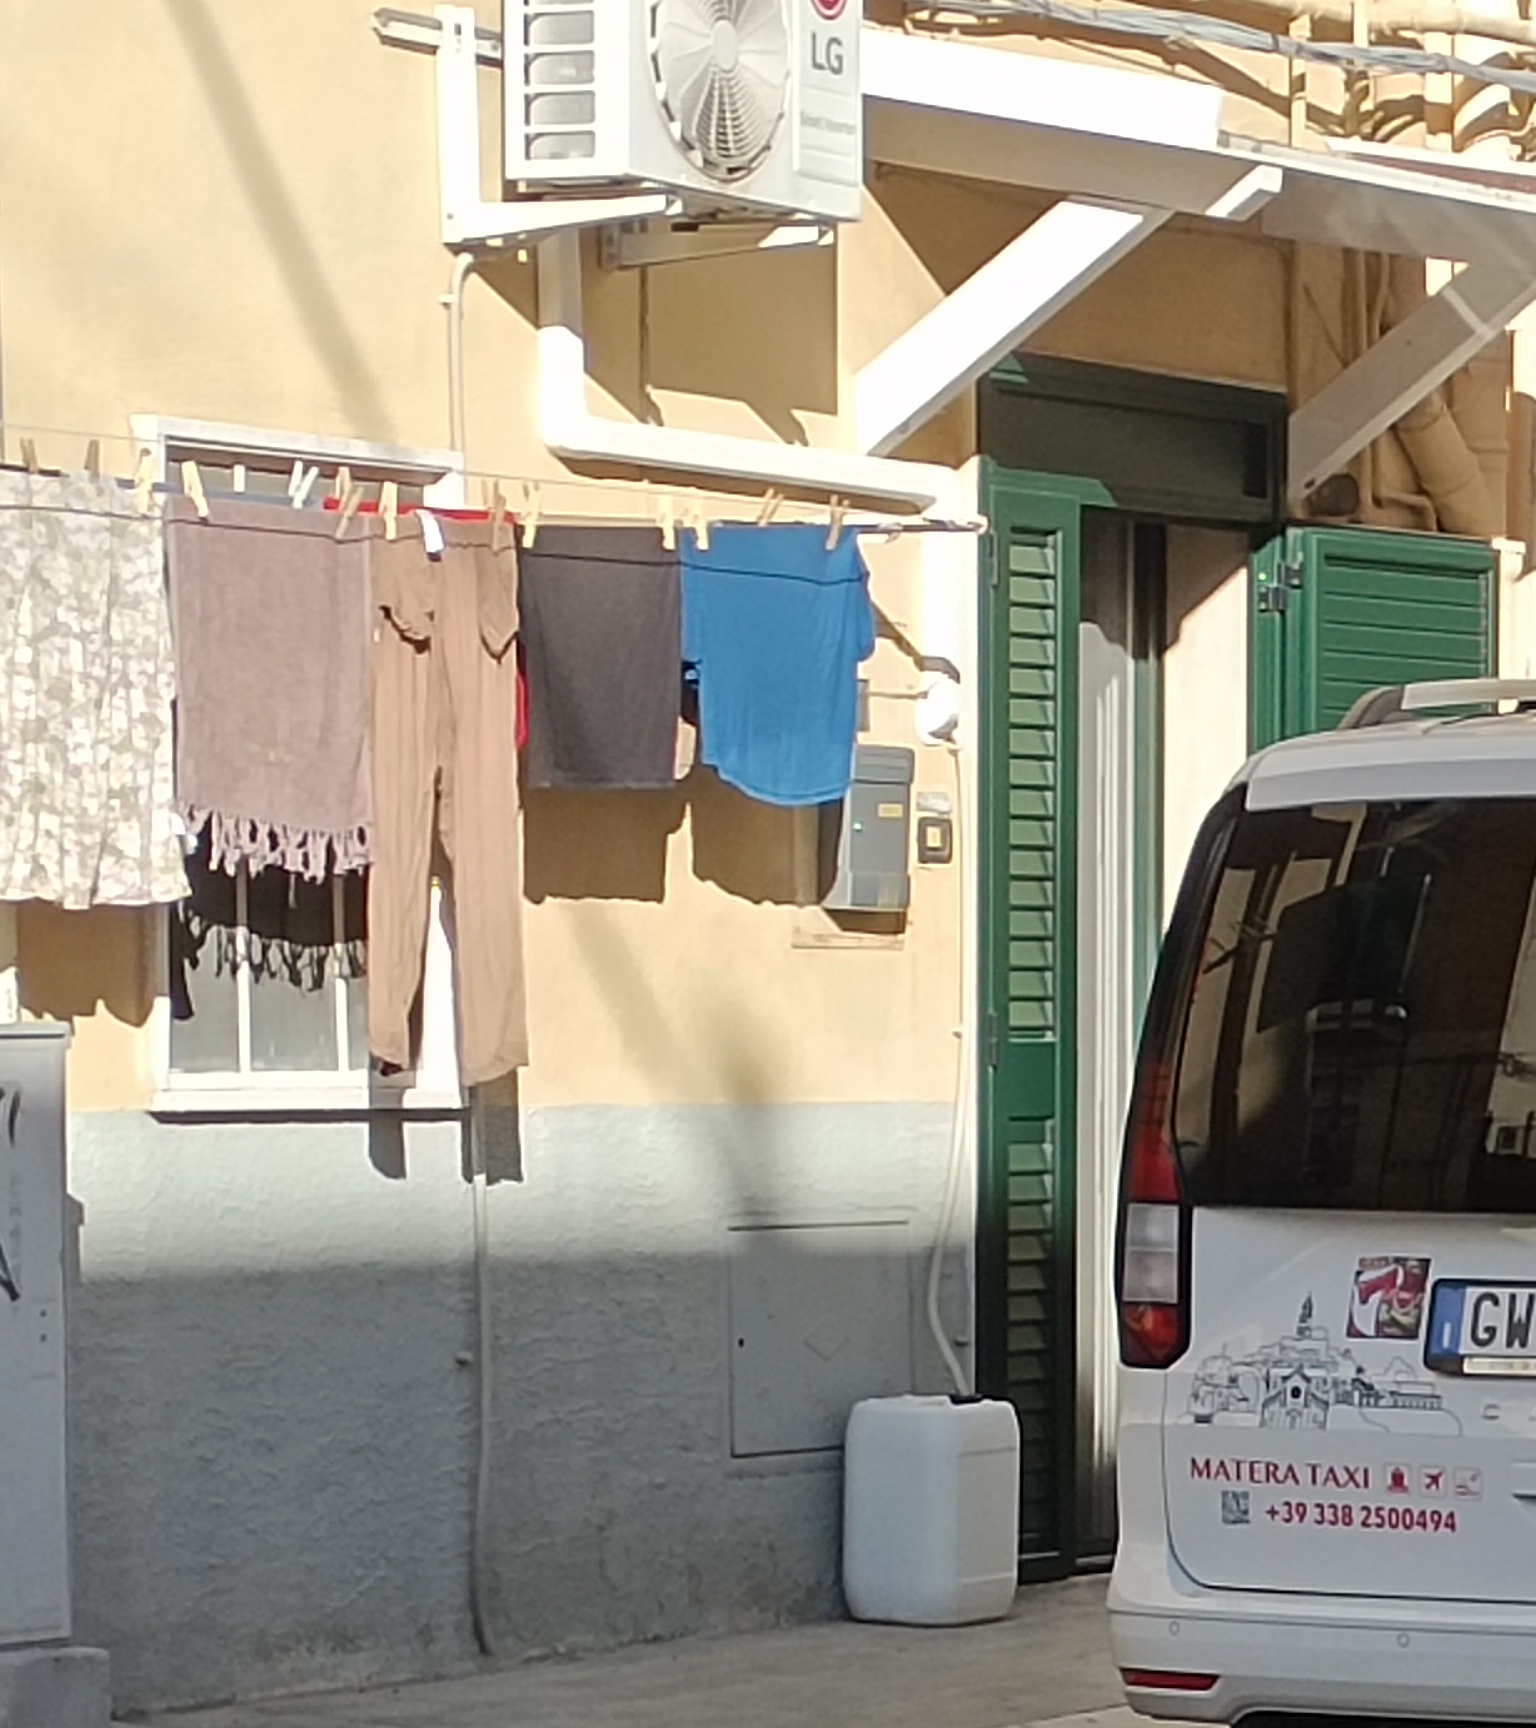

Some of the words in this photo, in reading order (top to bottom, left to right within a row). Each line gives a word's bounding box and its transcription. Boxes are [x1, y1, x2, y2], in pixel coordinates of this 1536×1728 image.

[811, 31, 843, 75] LG
[1470, 1292, 1536, 1349] GW
[1190, 1457, 1300, 1486] MATERA
[1306, 1463, 1370, 1489] TAXI
[1265, 1501, 1307, 1524] +39
[1314, 1503, 1354, 1526] 338
[1361, 1505, 1457, 1532] 2500494
